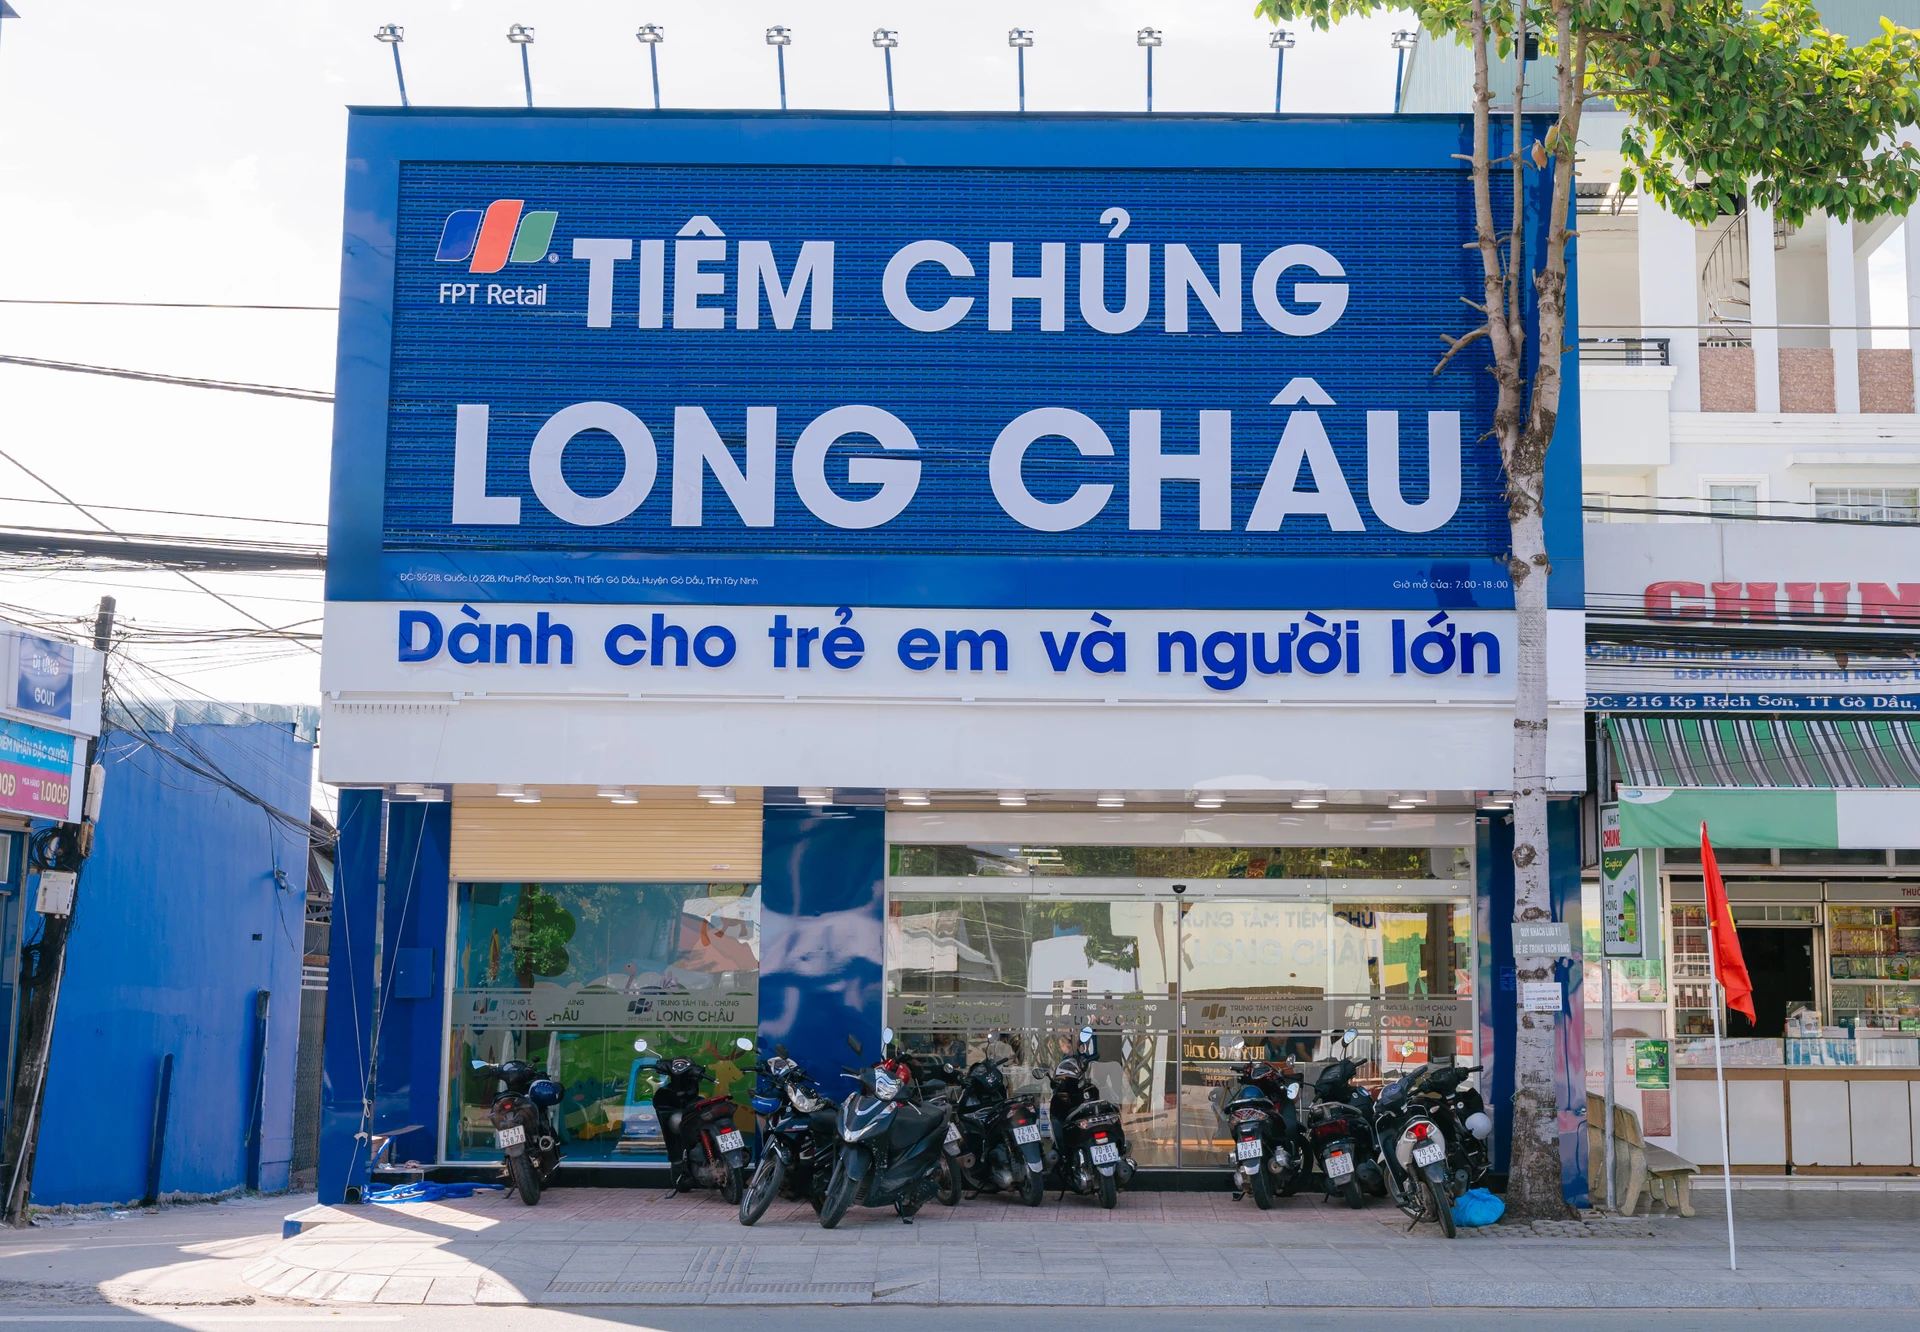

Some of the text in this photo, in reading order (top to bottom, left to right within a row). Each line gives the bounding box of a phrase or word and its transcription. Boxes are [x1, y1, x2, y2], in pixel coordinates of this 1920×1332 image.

[573, 207, 1350, 336] TIÊM CHỦNG
[439, 284, 547, 306] FPT Retail
[452, 378, 1462, 532] LONG CHÂU
[444, 573, 467, 582] Quốc
[468, 574, 478, 583] Lộ
[498, 574, 513, 582] Khu
[515, 573, 530, 582] Phố
[532, 575, 553, 584] Rạch
[555, 575, 572, 584] Sơn,
[574, 575, 585, 584] Thị
[586, 574, 604, 583] Trấn
[622, 575, 640, 584] Dầu,
[642, 577, 668, 585] Huyện
[670, 576, 683, 584] Gò
[685, 576, 704, 585] Dầu,
[724, 577, 737, 586] Tây
[1393, 580, 1410, 588] Giờ
[1412, 579, 1428, 588] mở
[399, 604, 1502, 690] Dành cho trẻ em và người lớn
[34, 687, 56, 707] GOUT
[1626, 695, 1662, 707] 216
[1669, 695, 1697, 709] Kp
[1703, 695, 1750, 709] Rạch
[1757, 695, 1799, 709] Sơn,
[1806, 696, 1832, 707] TT
[1839, 695, 1866, 708] Gò
[1872, 693, 1918, 710] Dầu,
[40, 780, 70, 805] 1.000Đ
[714, 998, 739, 1007] CHỦNG
[1255, 1003, 1271, 1012] TÂM
[1272, 1003, 1286, 1012] TIÊM
[1288, 1004, 1313, 1012] CHỦNG
[1415, 1003, 1430, 1012] TIÊM
[1431, 1004, 1457, 1012] CHỦNG
[501, 1010, 537, 1021] LONG
[656, 1008, 734, 1022] LONG CHÂU
[1271, 1013, 1308, 1027] CHÂU
[1415, 1012, 1452, 1027] CHÂU
[1095, 1145, 1113, 1154] 70-B1
[1240, 1141, 1258, 1151] 70-F1
[1331, 1163, 1351, 1176] 2530
